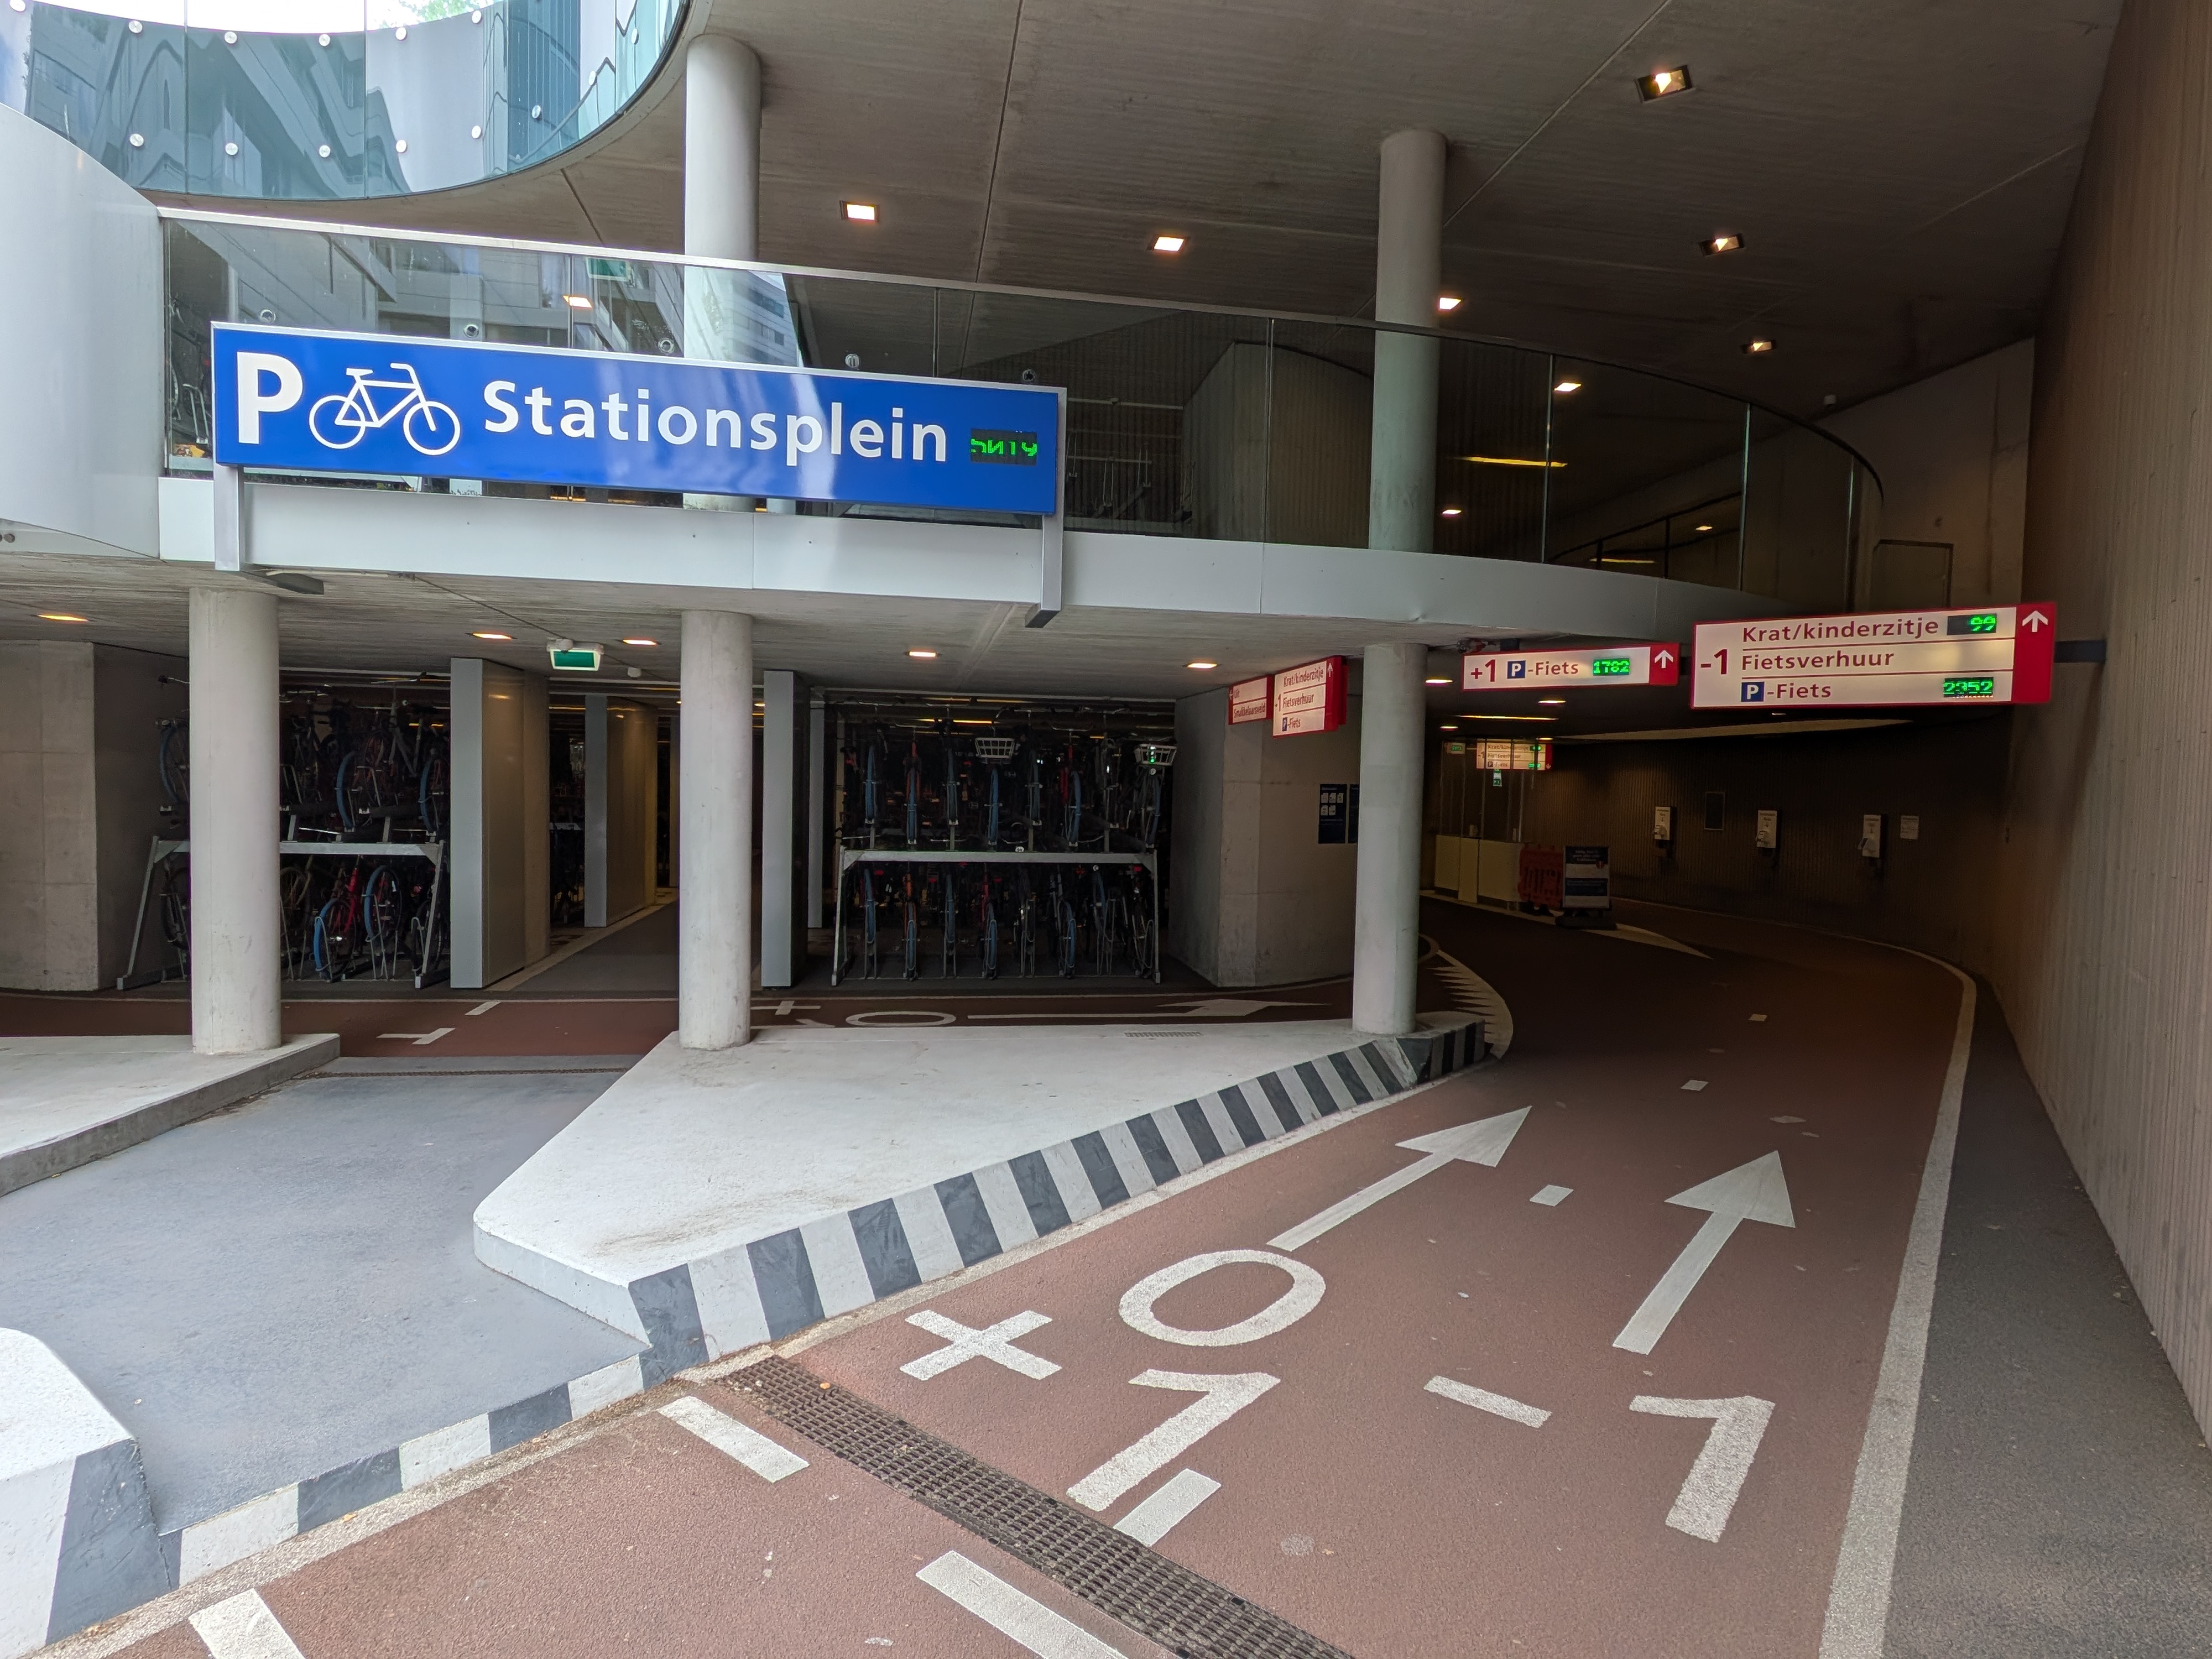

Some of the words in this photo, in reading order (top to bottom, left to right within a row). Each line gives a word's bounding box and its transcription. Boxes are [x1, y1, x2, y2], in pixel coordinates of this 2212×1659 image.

[236, 352, 303, 444] P
[483, 380, 946, 466] Stationsplein
[1743, 617, 1939, 643] Krat/kinderzitje
[1970, 615, 1996, 632] 99
[1470, 659, 1496, 682] +1
[1700, 649, 1729, 675] -1
[1741, 650, 1895, 671] Fietsverhuur
[1282, 692, 1314, 708] Fietsverhuur
[1118, 1249, 1326, 1347] 0
